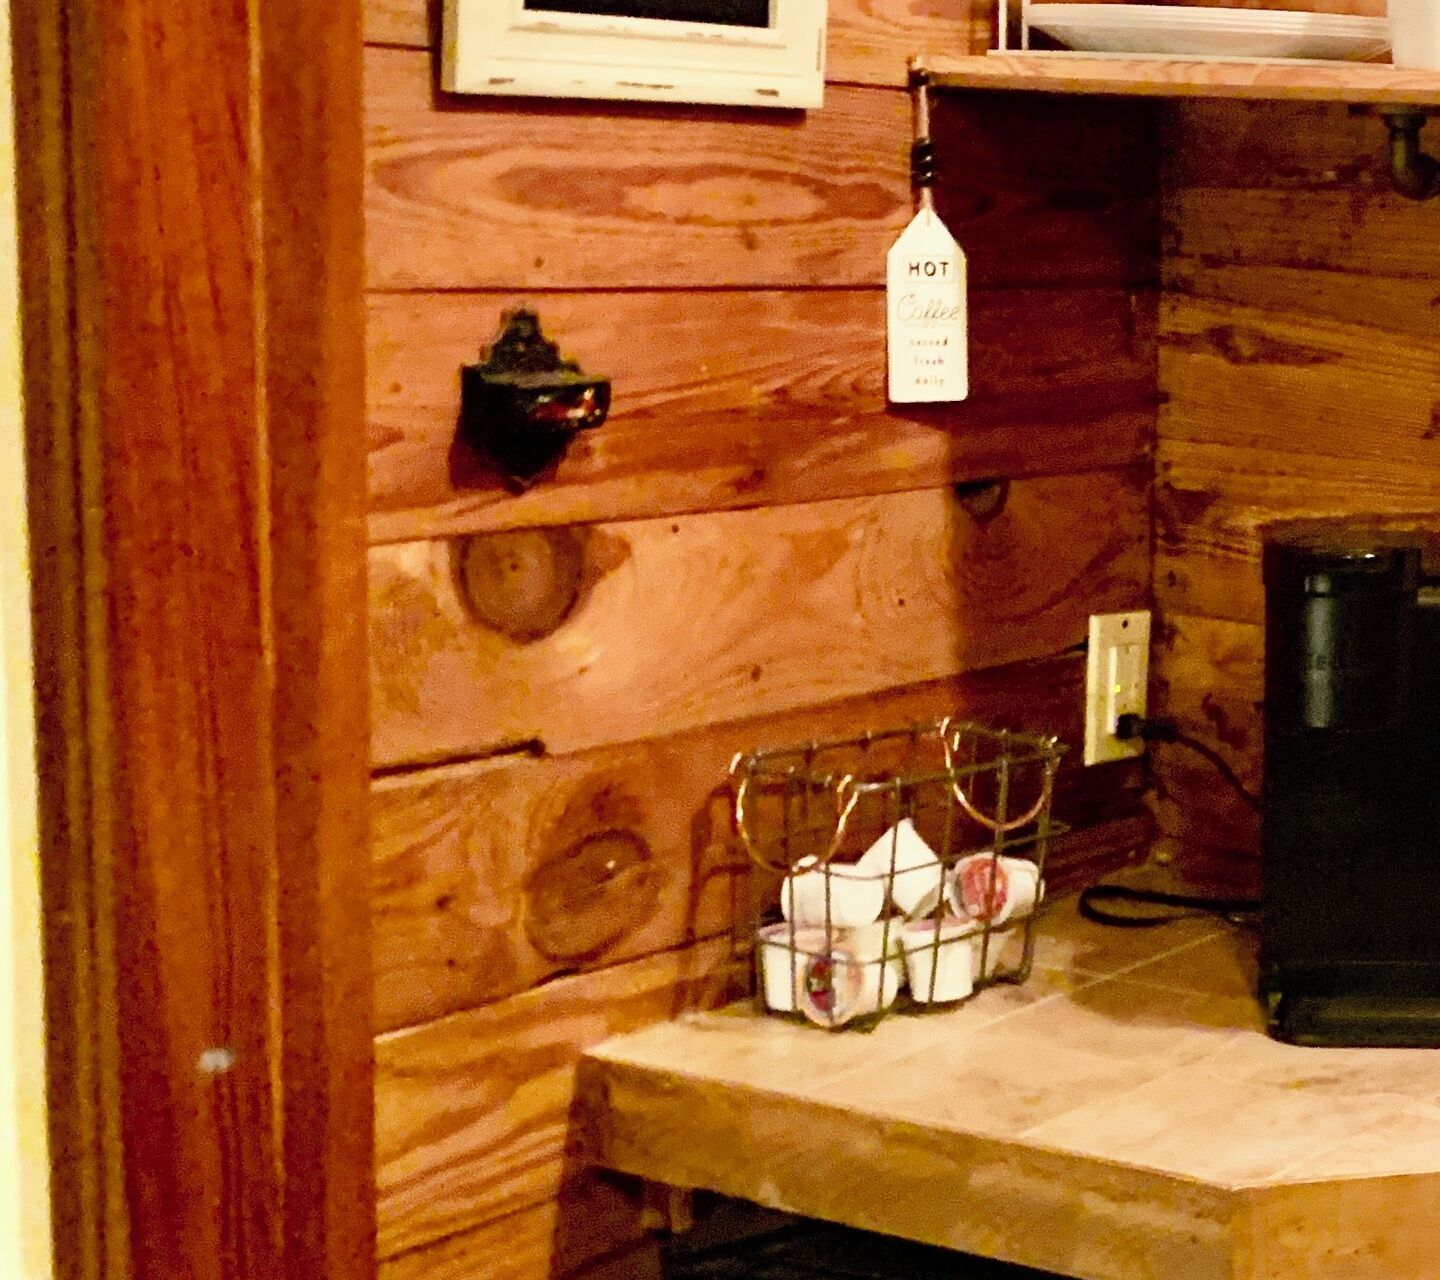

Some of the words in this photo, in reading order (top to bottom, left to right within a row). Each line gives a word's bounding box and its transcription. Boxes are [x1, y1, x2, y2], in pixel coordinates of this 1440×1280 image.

[908, 261, 949, 277] HOT
[896, 292, 961, 328] Coffee
[909, 337, 949, 347] served
